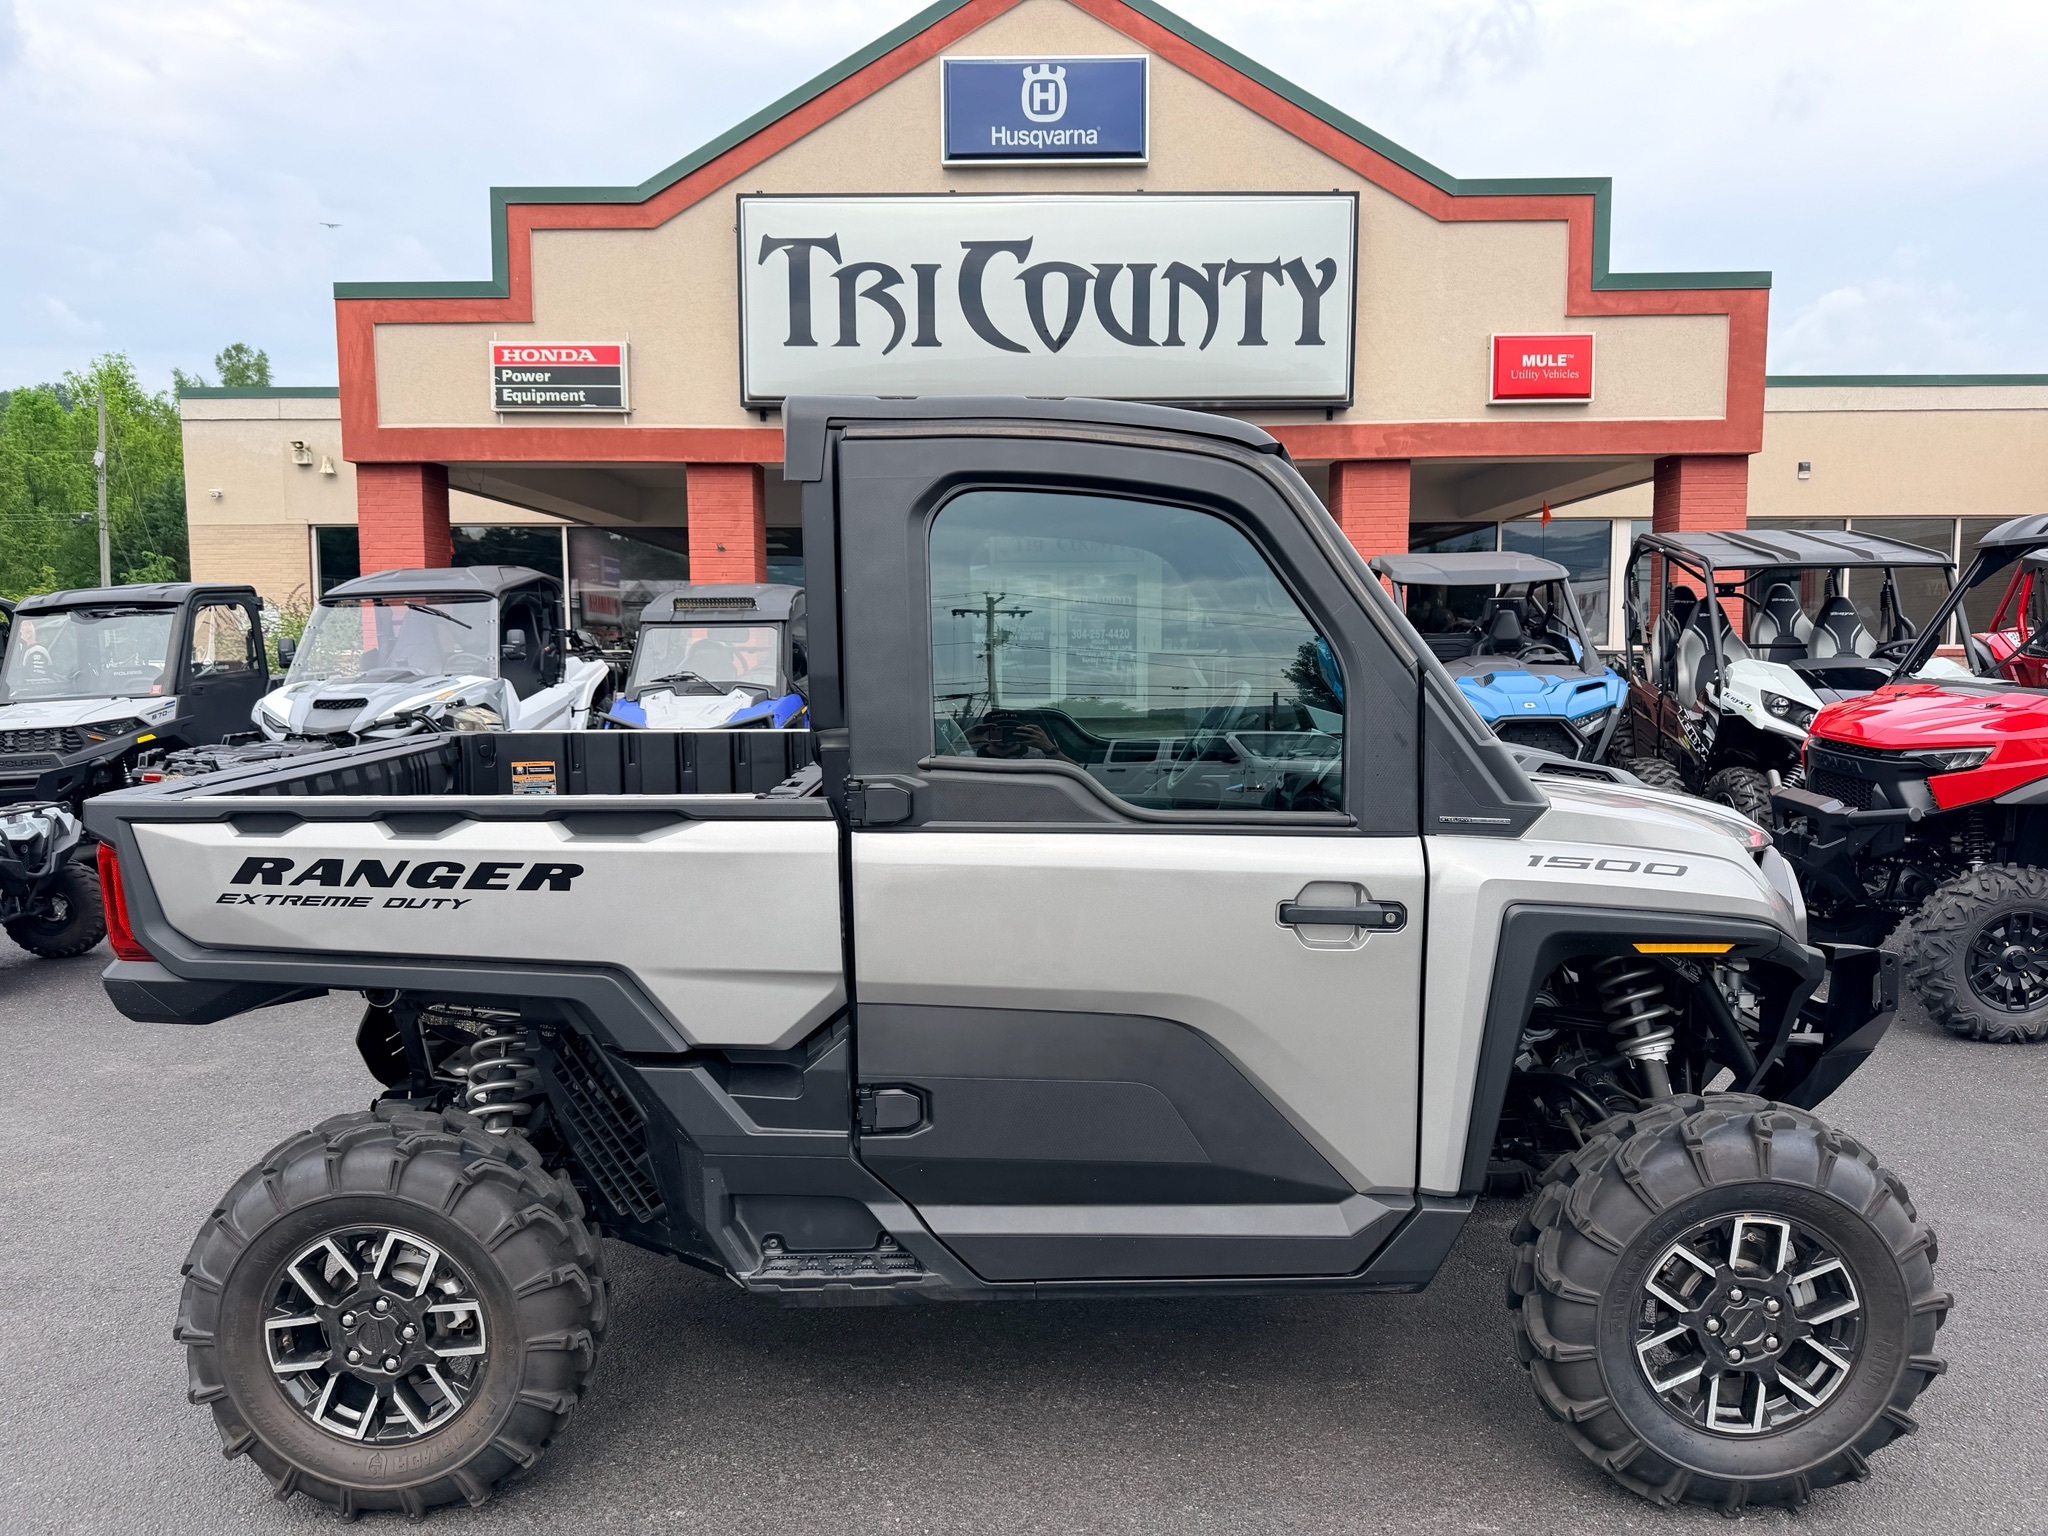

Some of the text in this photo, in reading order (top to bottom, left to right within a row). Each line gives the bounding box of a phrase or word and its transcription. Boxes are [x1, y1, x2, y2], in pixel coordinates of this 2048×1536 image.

[991, 126, 1099, 149] Husqvarna
[501, 349, 598, 362] HONDA
[501, 369, 551, 382] Power
[1510, 368, 1580, 381] Utility Vehicles
[502, 388, 586, 404] Equipment
[1071, 628, 1131, 639] 304-257-4420
[1527, 854, 1688, 877] 1500
[229, 856, 584, 892] RANGER
[216, 893, 473, 910] EXTREME DUTY
